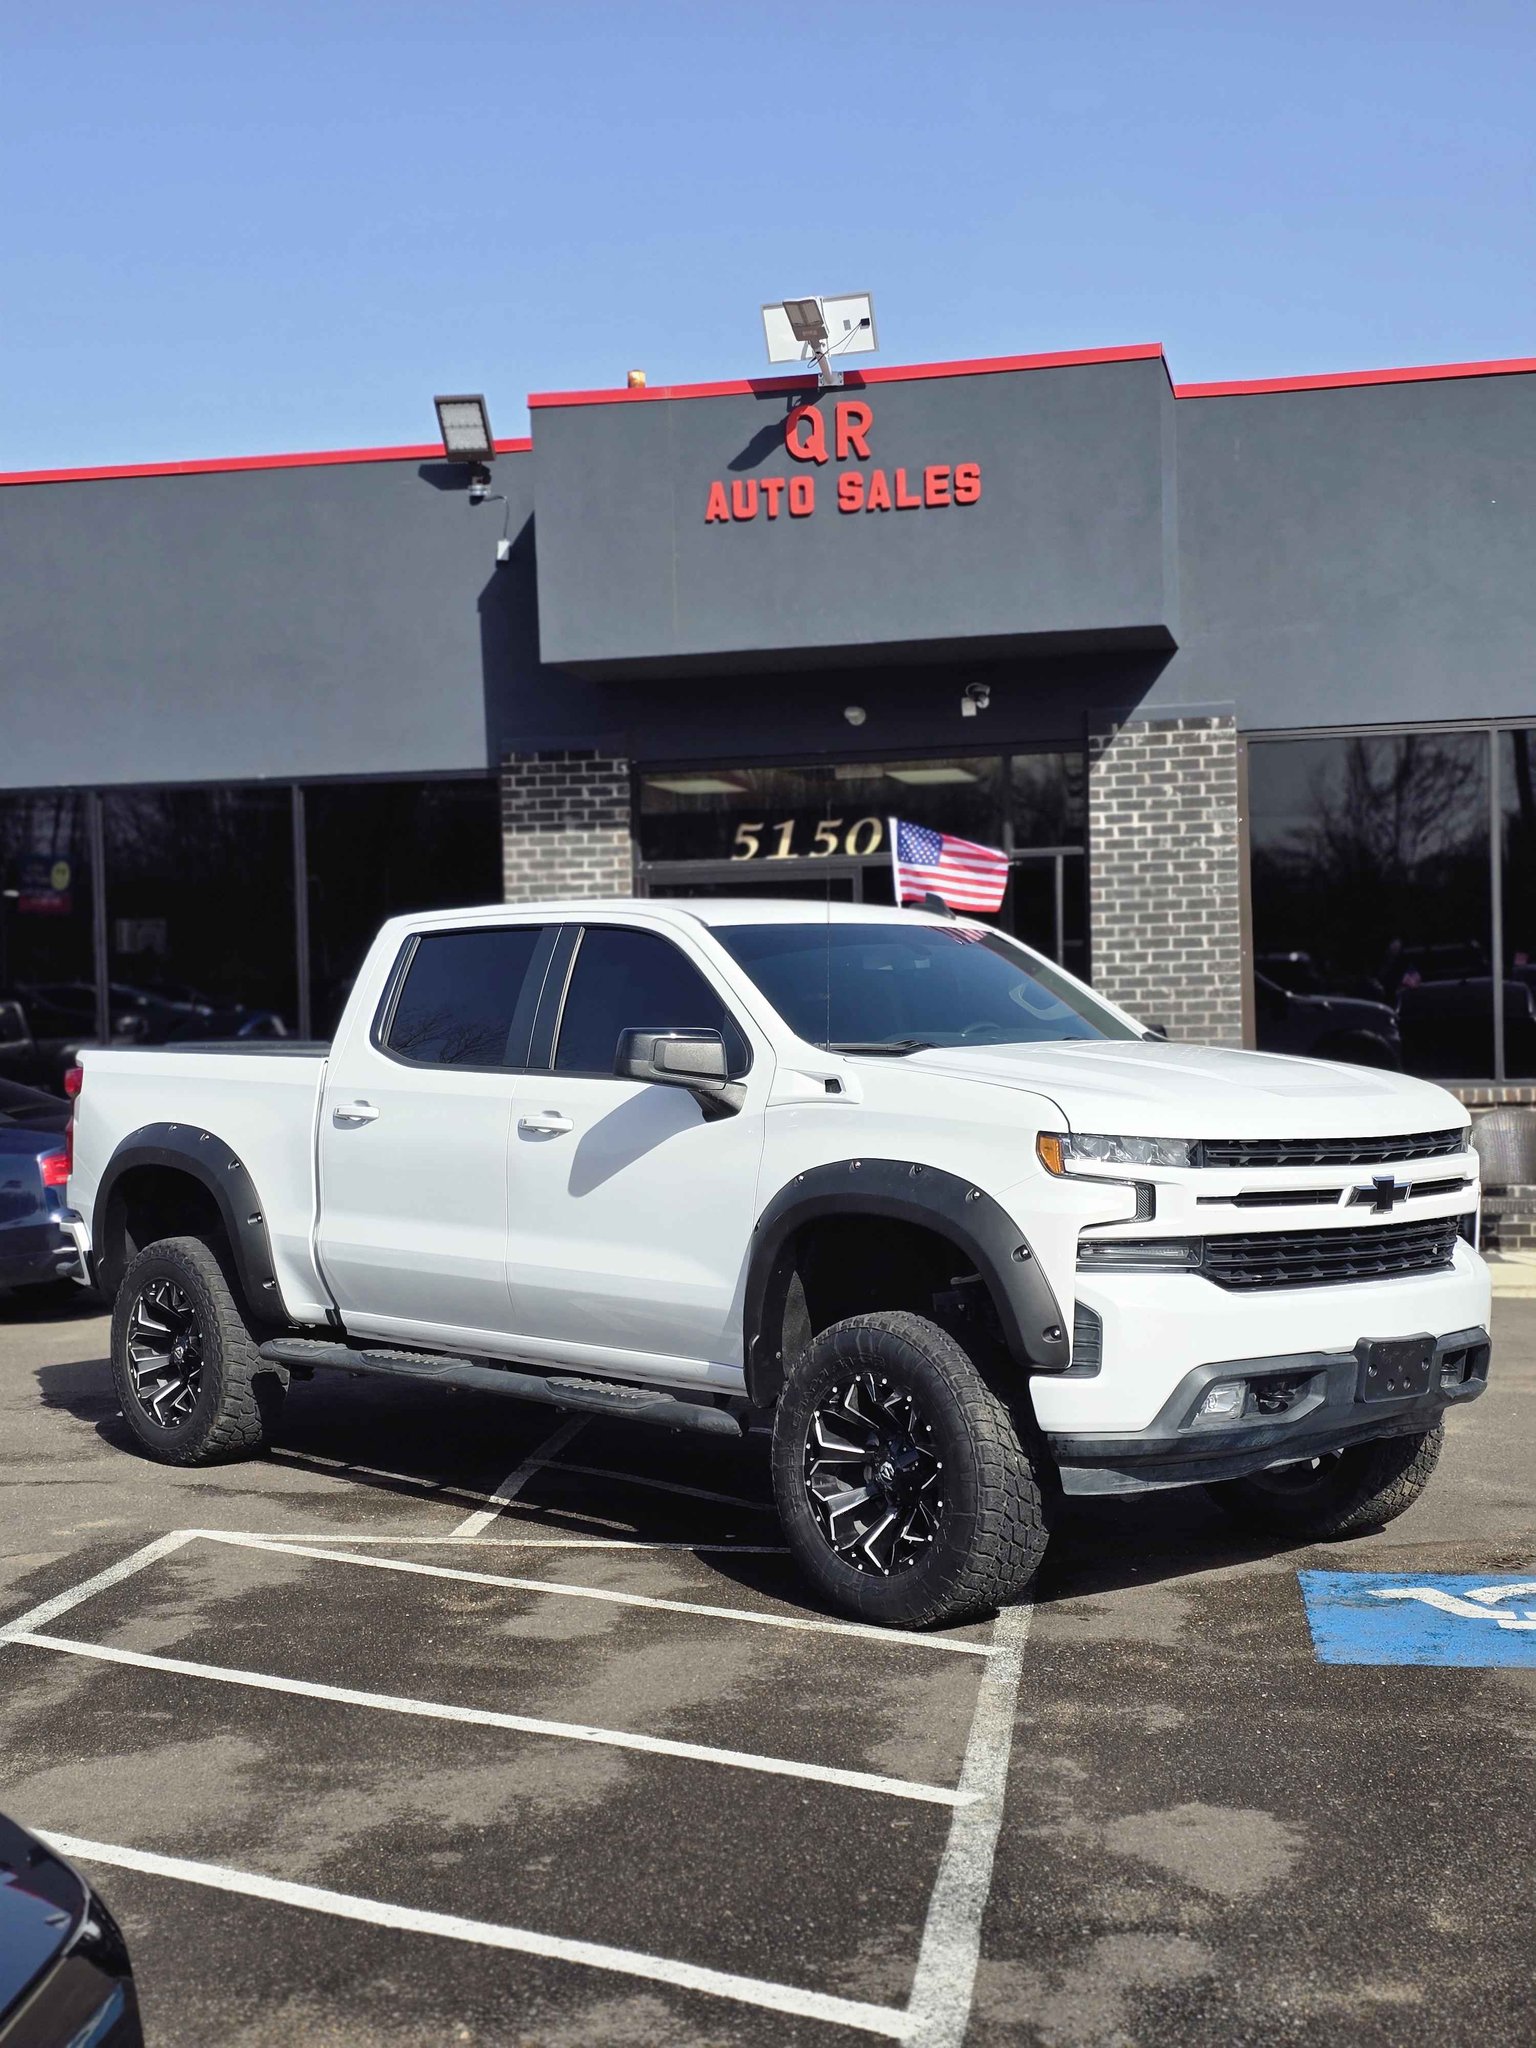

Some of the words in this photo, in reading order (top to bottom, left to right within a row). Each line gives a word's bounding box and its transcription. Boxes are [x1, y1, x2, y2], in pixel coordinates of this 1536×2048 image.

[786, 401, 873, 463] QR
[706, 476, 815, 521] AUTO
[837, 463, 981, 512] SALES
[731, 816, 883, 861] 5150
